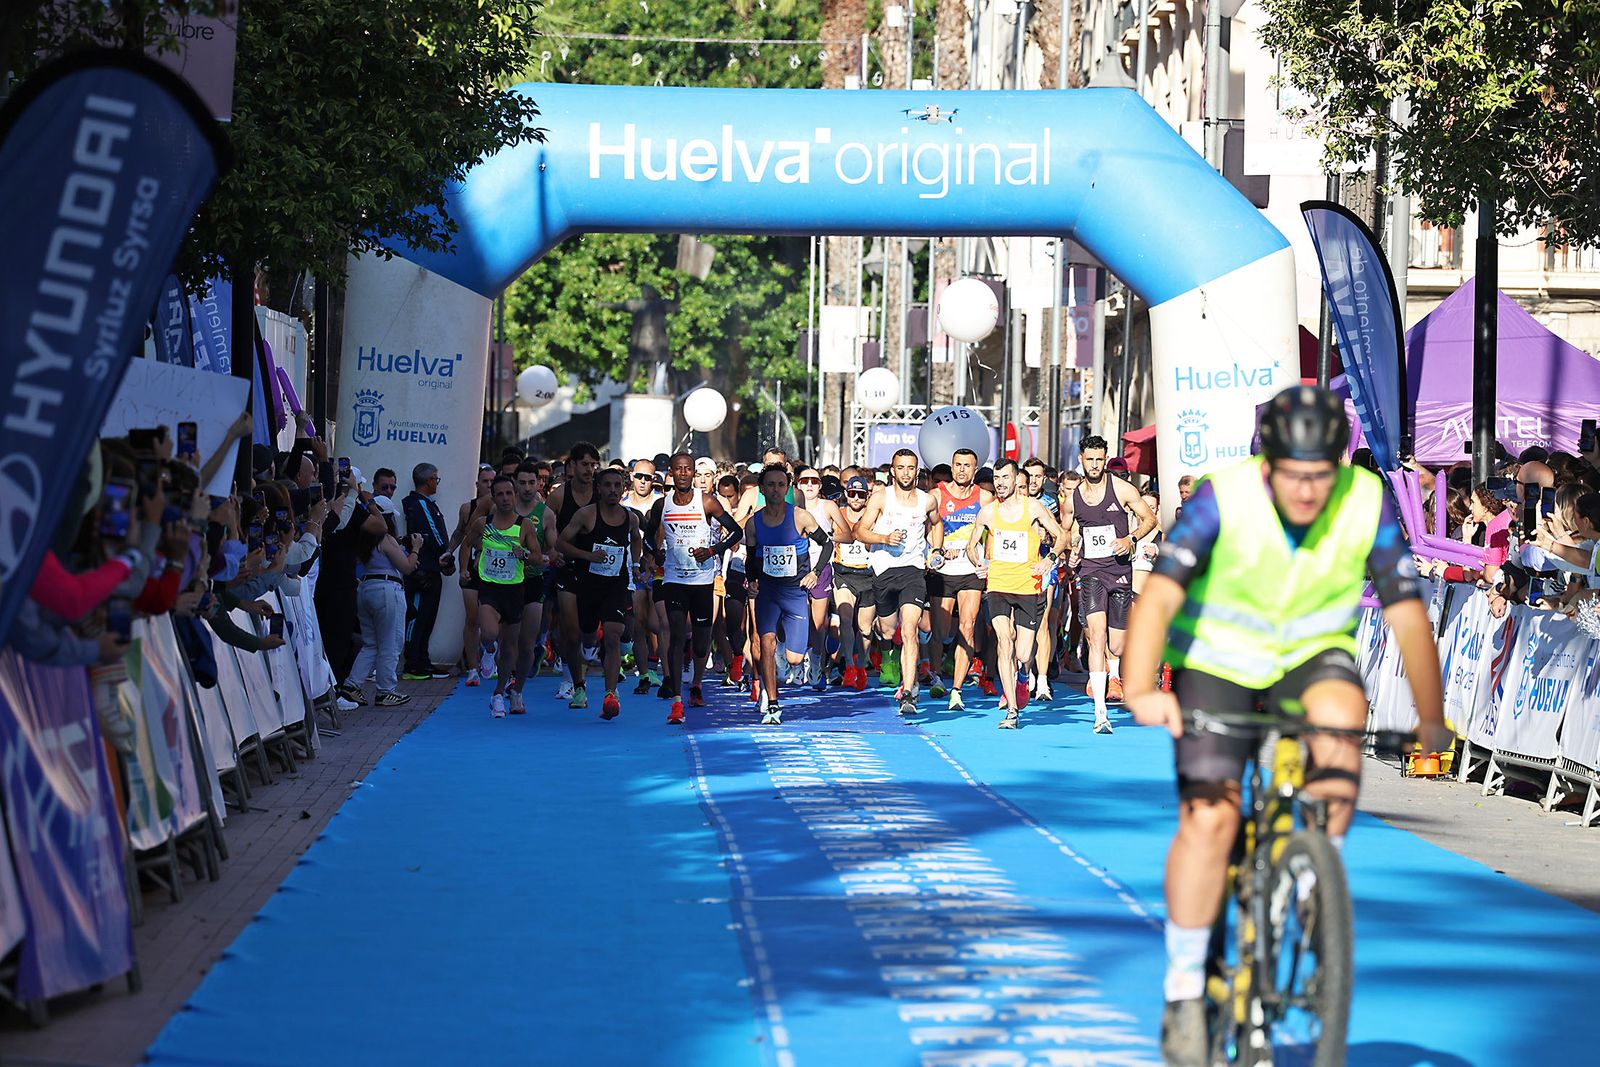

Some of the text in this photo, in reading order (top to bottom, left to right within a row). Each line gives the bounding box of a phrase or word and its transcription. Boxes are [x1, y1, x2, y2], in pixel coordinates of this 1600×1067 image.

[589, 122, 1051, 199] Huelva original
[3, 94, 137, 439] HYUNDAI
[357, 346, 455, 378] Huelva
[1175, 362, 1273, 392] Huelva
[417, 379, 454, 390] original
[934, 408, 971, 427] 1:15
[388, 419, 449, 431] Ayuntamiento de
[386, 429, 448, 446] HUELVA
[874, 431, 917, 445] Run to
[1215, 445, 1250, 459] HUE
[1002, 539, 1017, 551] 54
[1092, 535, 1107, 547] 56
[848, 544, 862, 555] 23
[491, 557, 506, 569] 49
[765, 554, 794, 566] 1337
